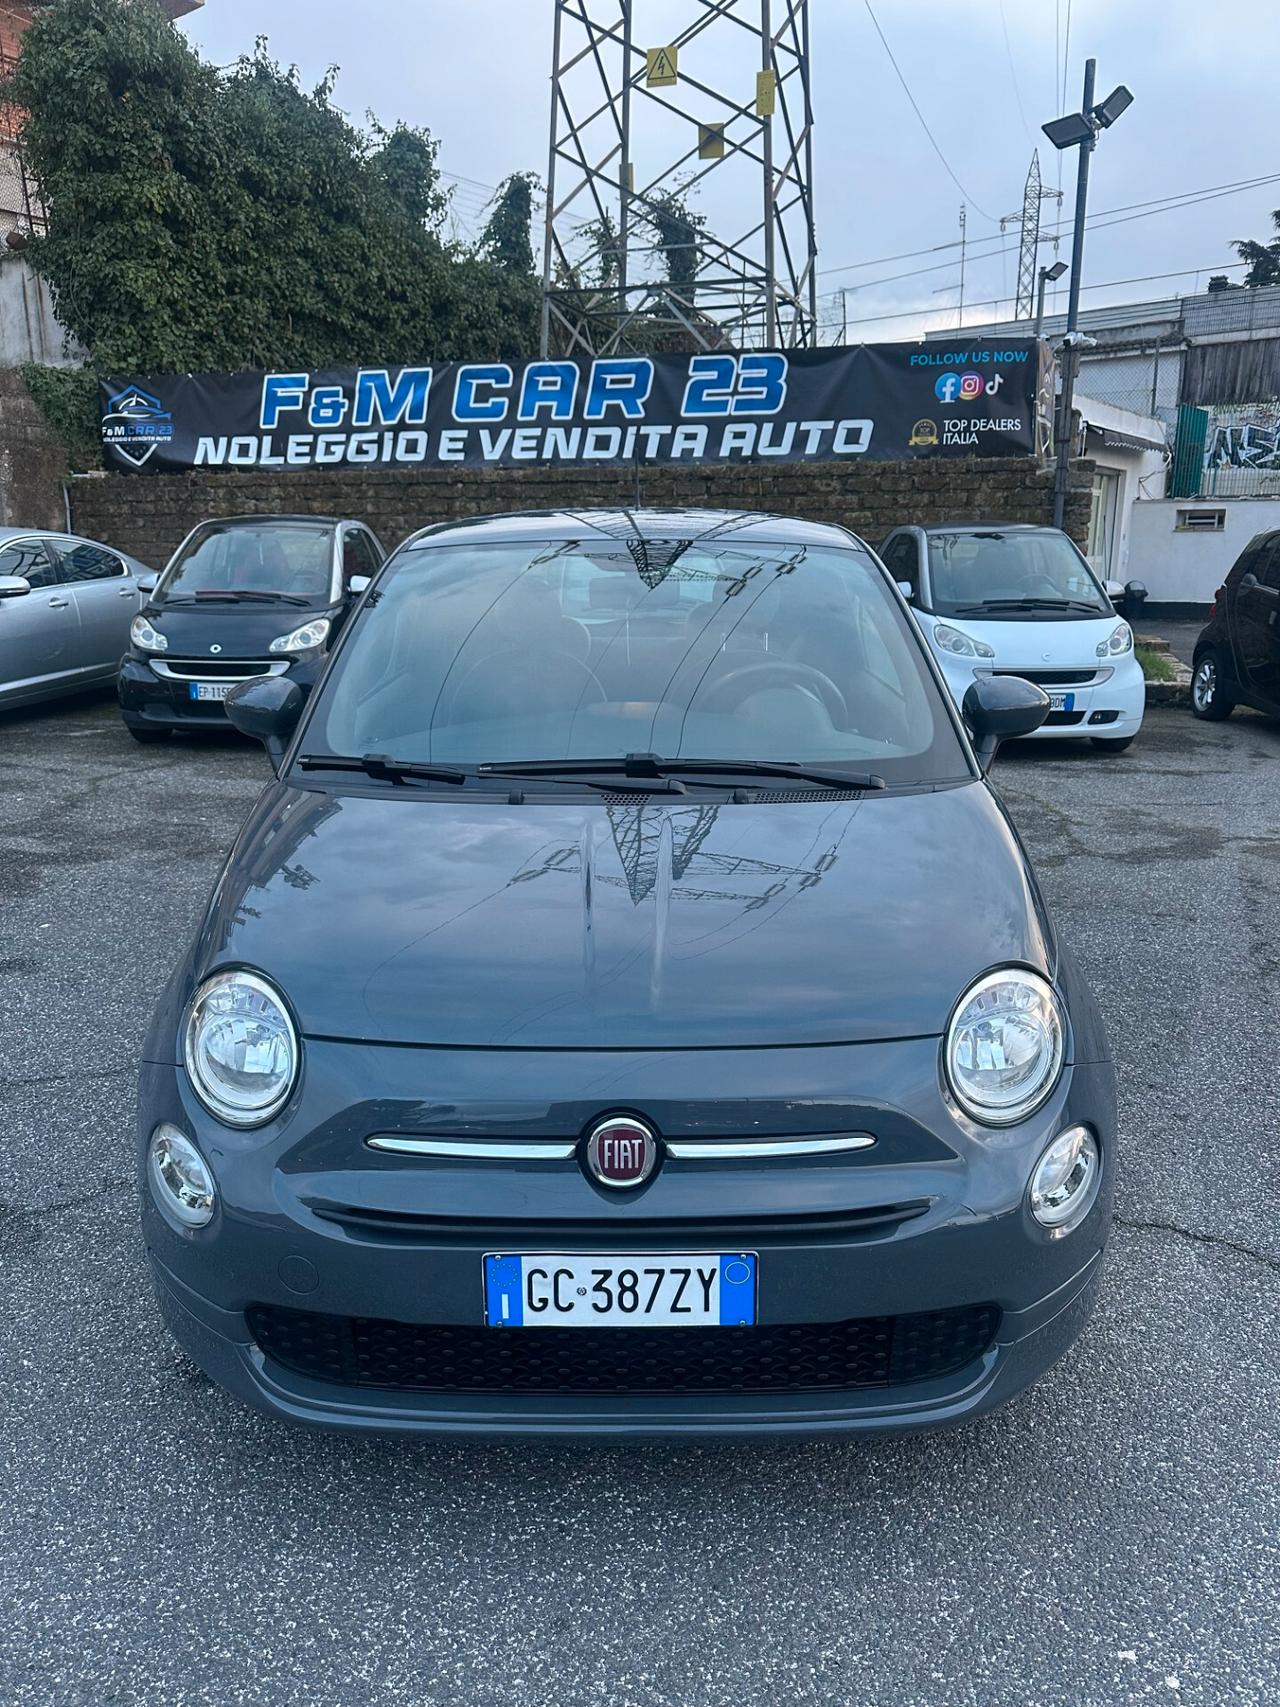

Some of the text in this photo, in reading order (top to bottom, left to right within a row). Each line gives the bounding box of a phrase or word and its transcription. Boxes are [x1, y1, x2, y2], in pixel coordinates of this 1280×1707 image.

[910, 351, 1029, 367] FOLLOW US NOW
[259, 352, 789, 429] F&M CAR 23
[943, 418, 1022, 432] TOP DEALERS
[193, 419, 874, 465] NOLEGGIO E VENDITA AUTO
[942, 432, 979, 445] ITALIA
[604, 1139, 643, 1169] FIAT
